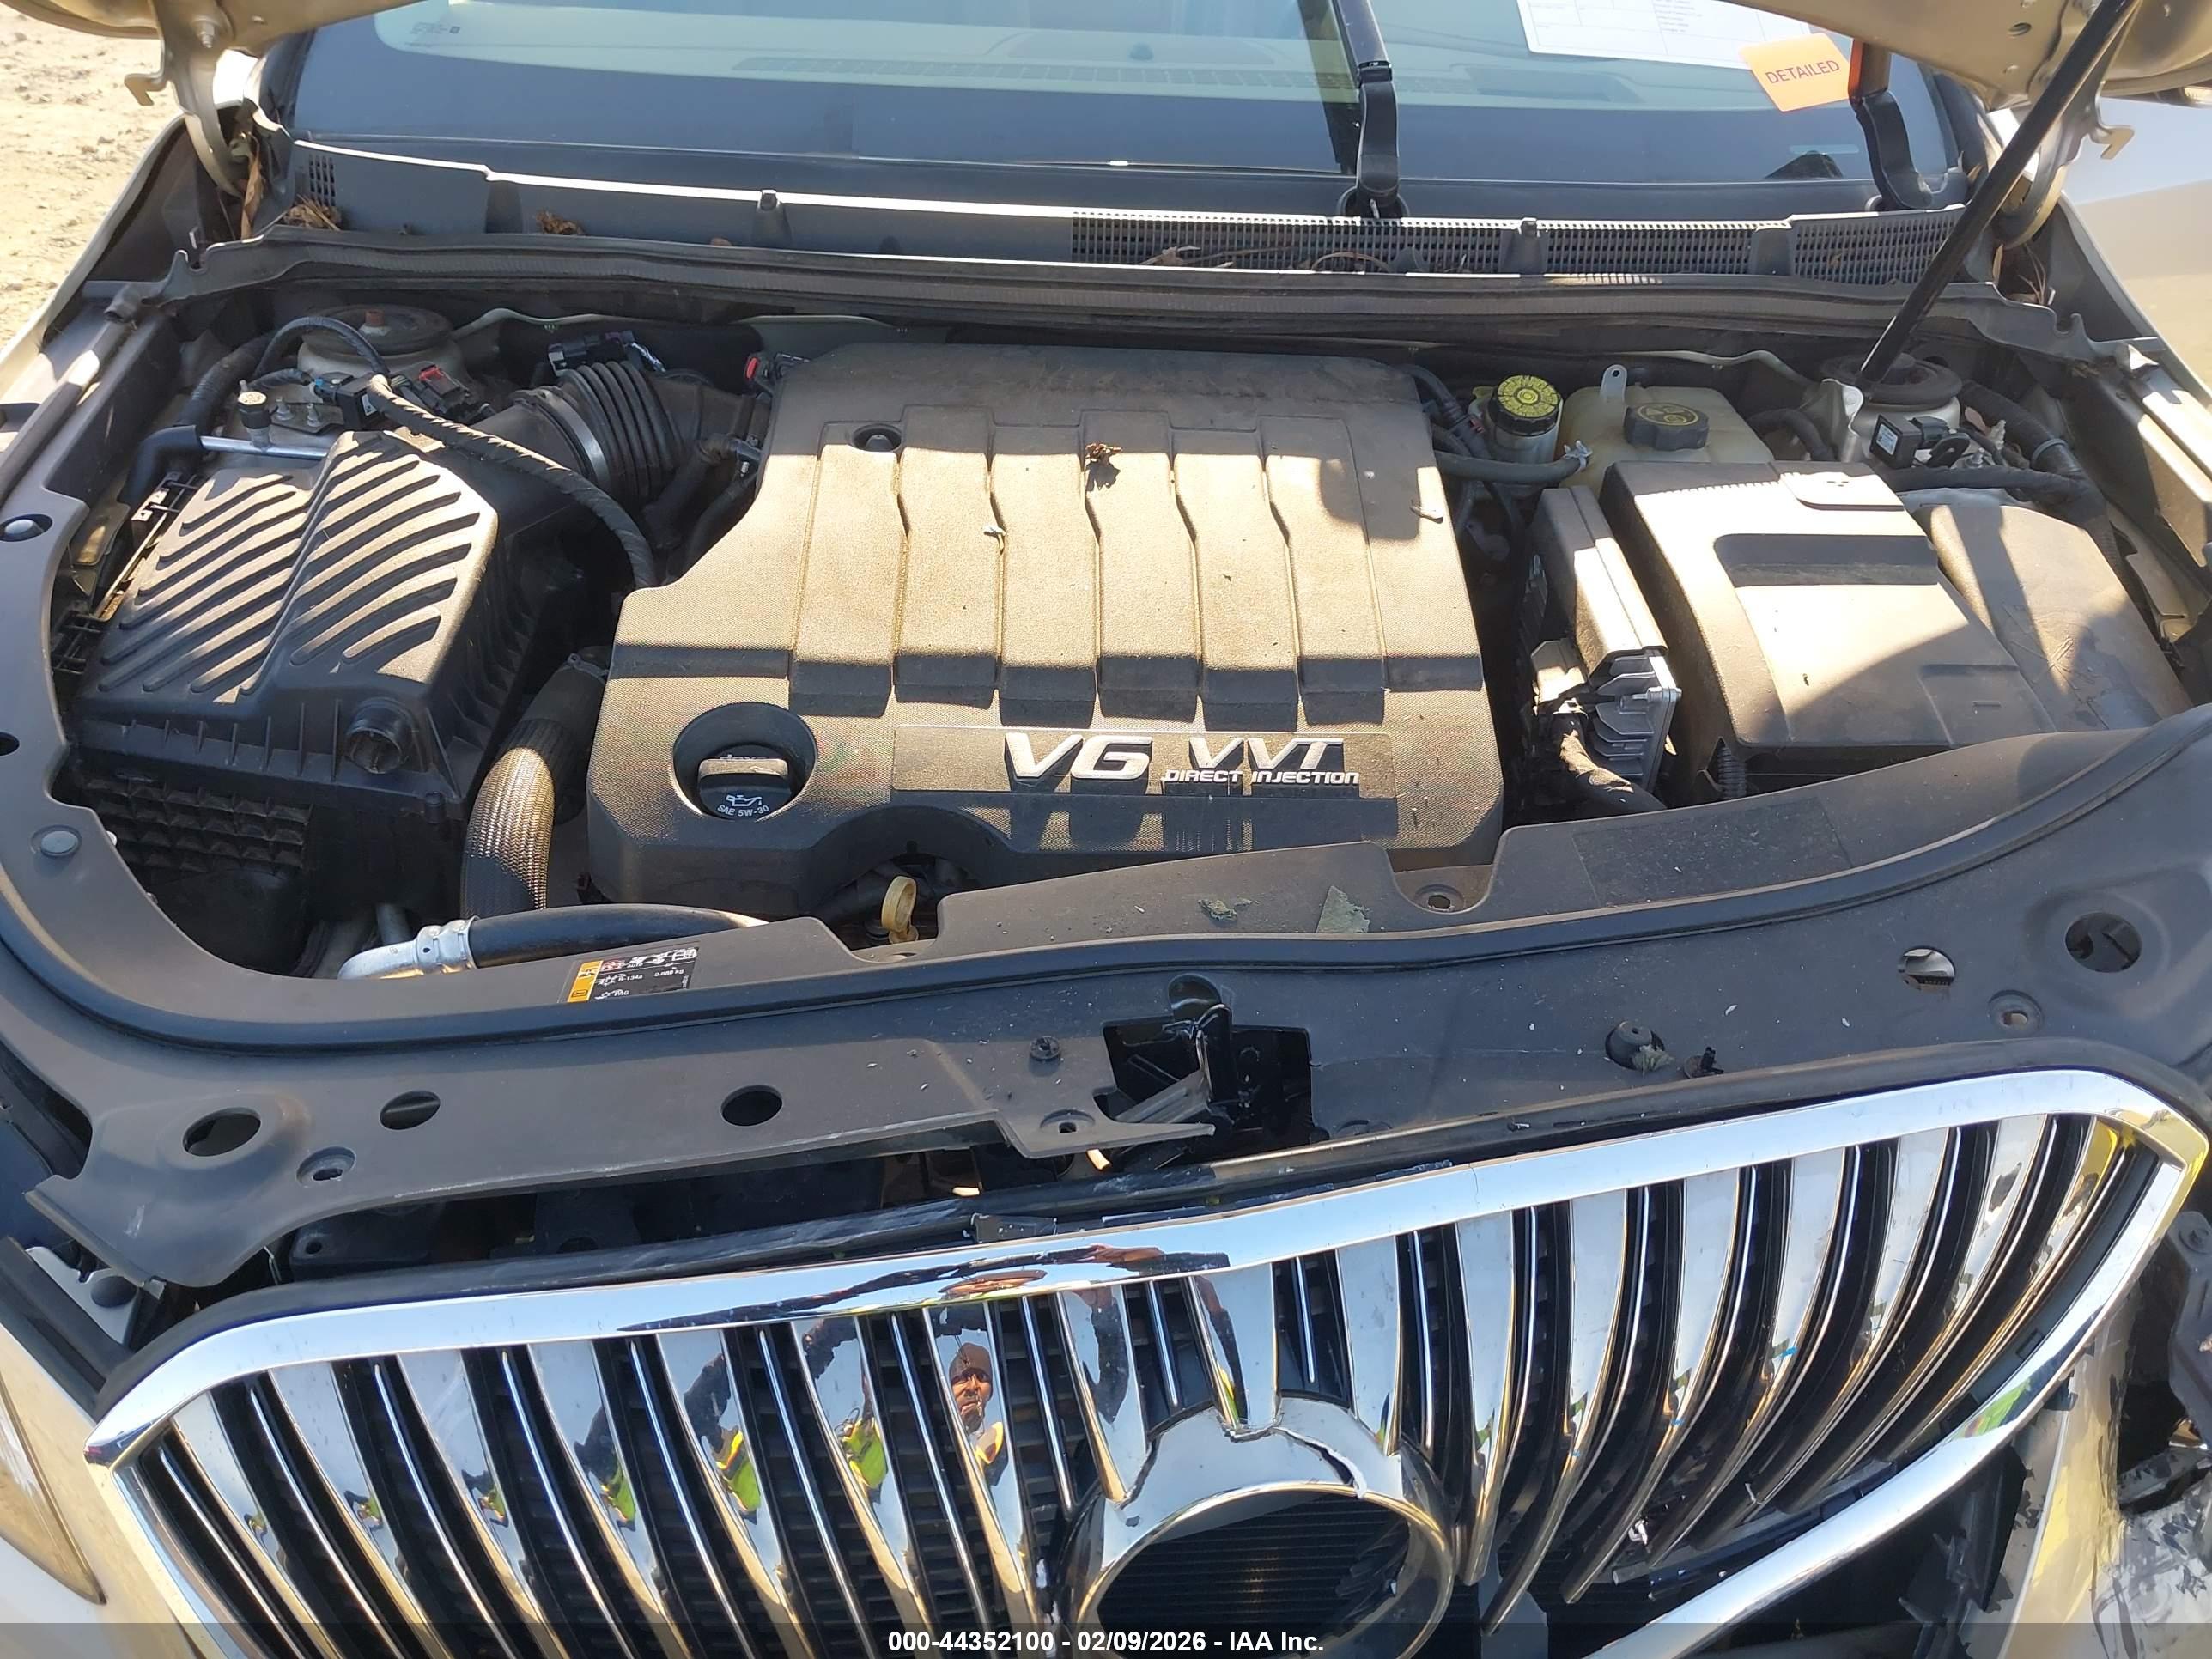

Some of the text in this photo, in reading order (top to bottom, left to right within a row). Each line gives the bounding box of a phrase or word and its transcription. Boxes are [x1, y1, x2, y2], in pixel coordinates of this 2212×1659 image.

[1765, 59, 1841, 85] DETAILED
[1005, 732, 1345, 780] V6 VVT
[1163, 770, 1360, 786] DIRECT INJECTION
[717, 804, 770, 817] SAE 5W-30
